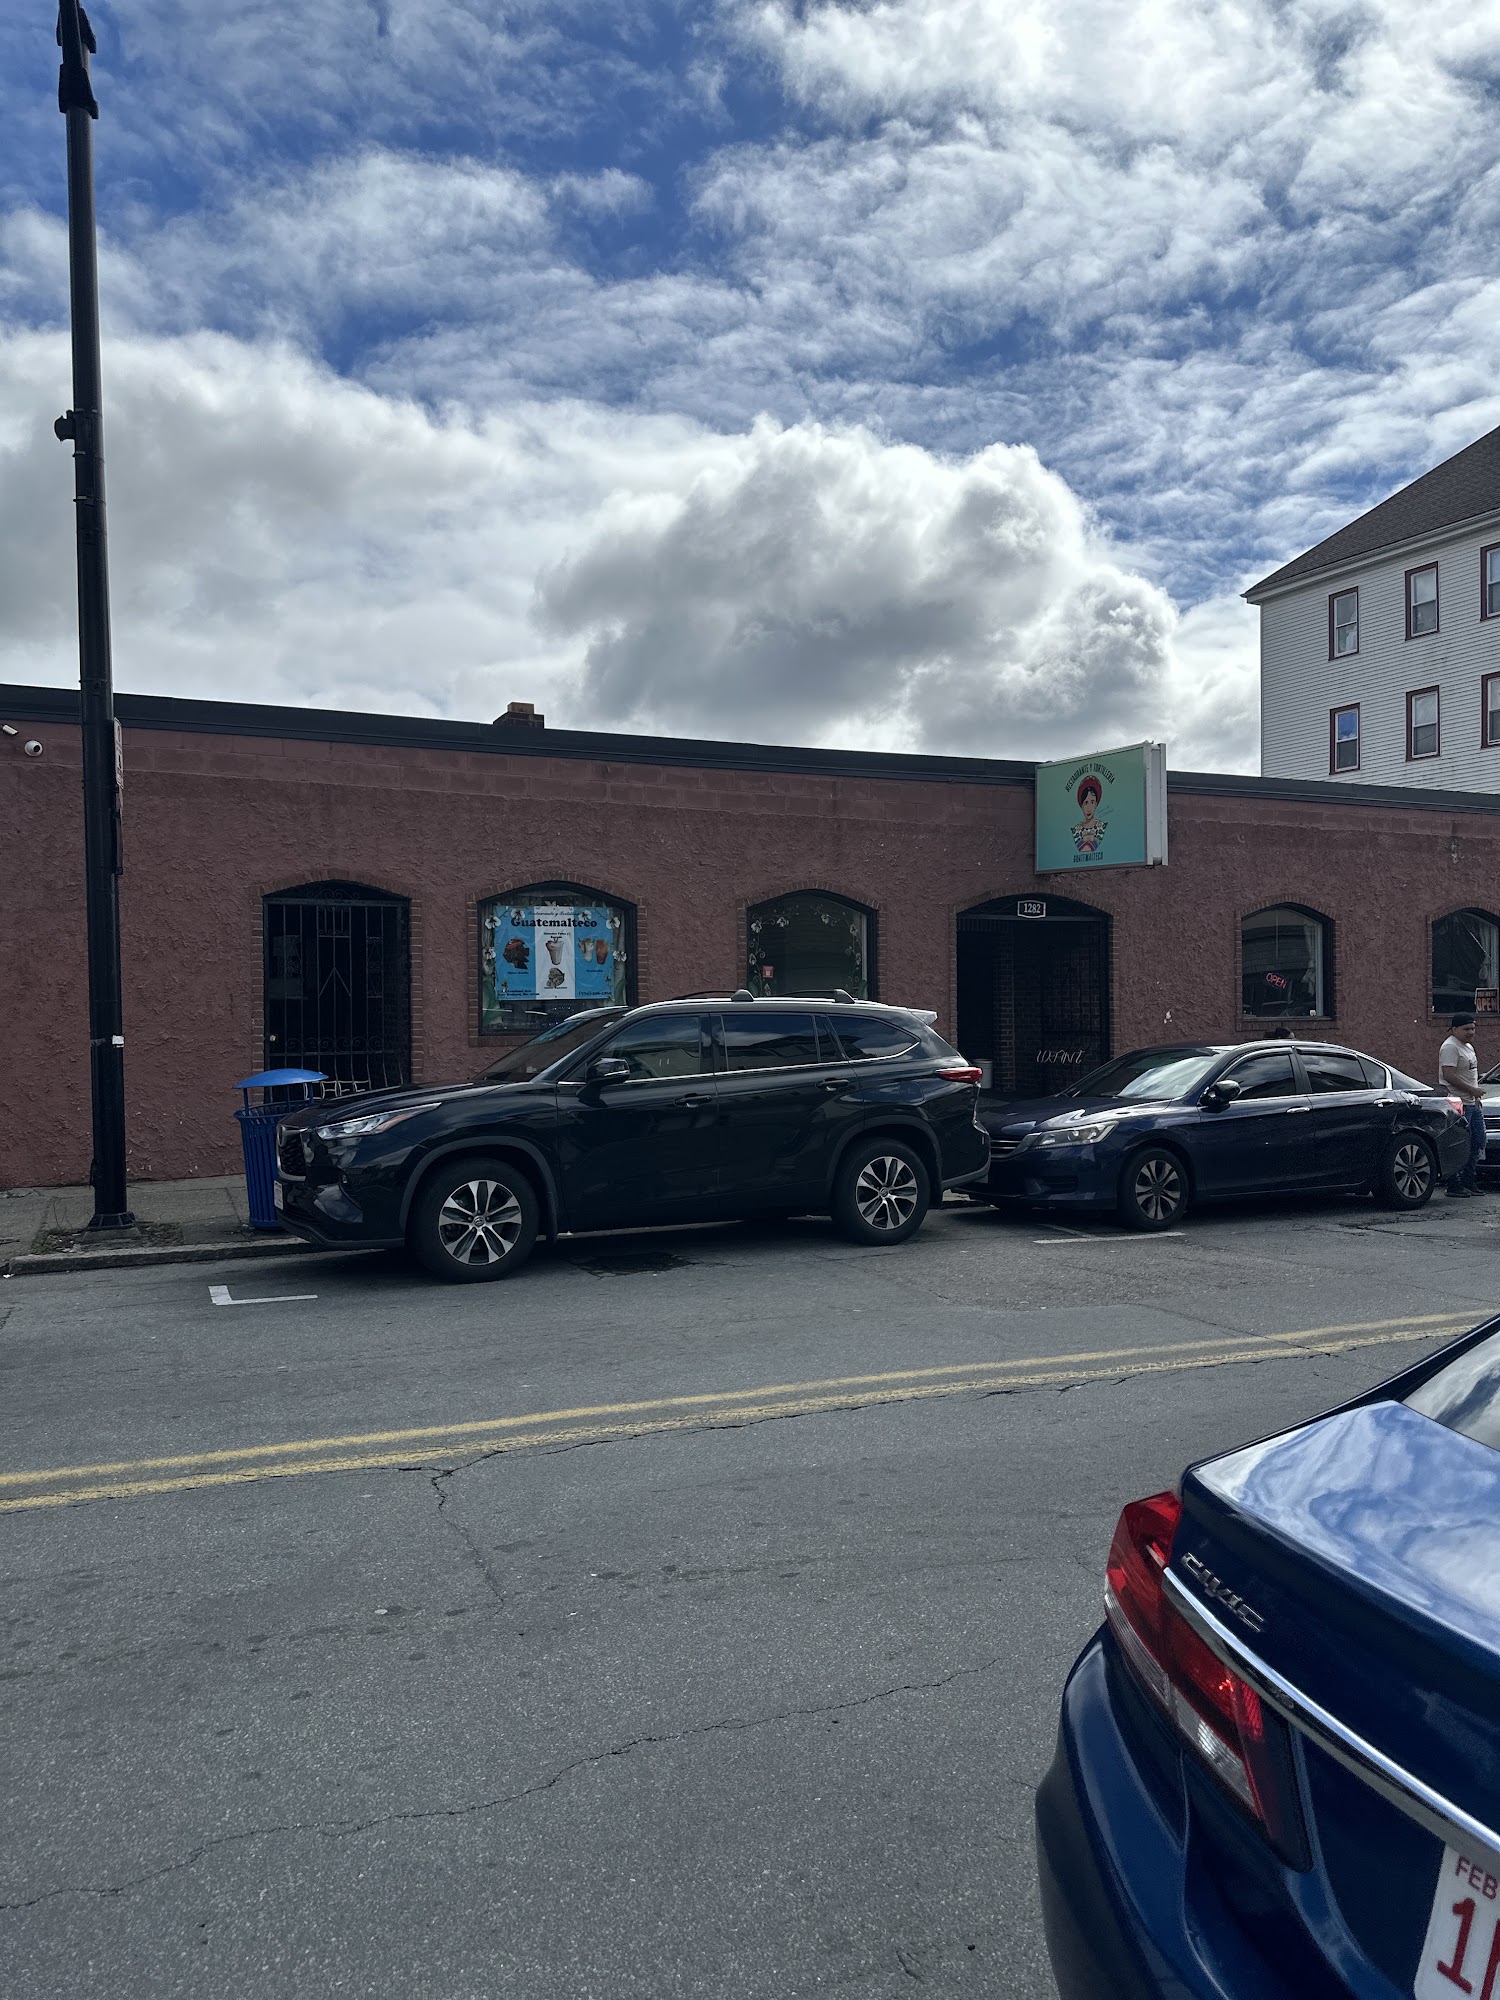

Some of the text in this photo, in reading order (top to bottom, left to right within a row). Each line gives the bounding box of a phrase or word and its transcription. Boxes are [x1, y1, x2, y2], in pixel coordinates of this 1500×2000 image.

[1023, 902, 1041, 914] 1282
[511, 917, 598, 928] Guatemalteco
[1265, 972, 1287, 989] OPEN
[1181, 1552, 1264, 1632] CIVIC
[1455, 1855, 1499, 1900] FEB
